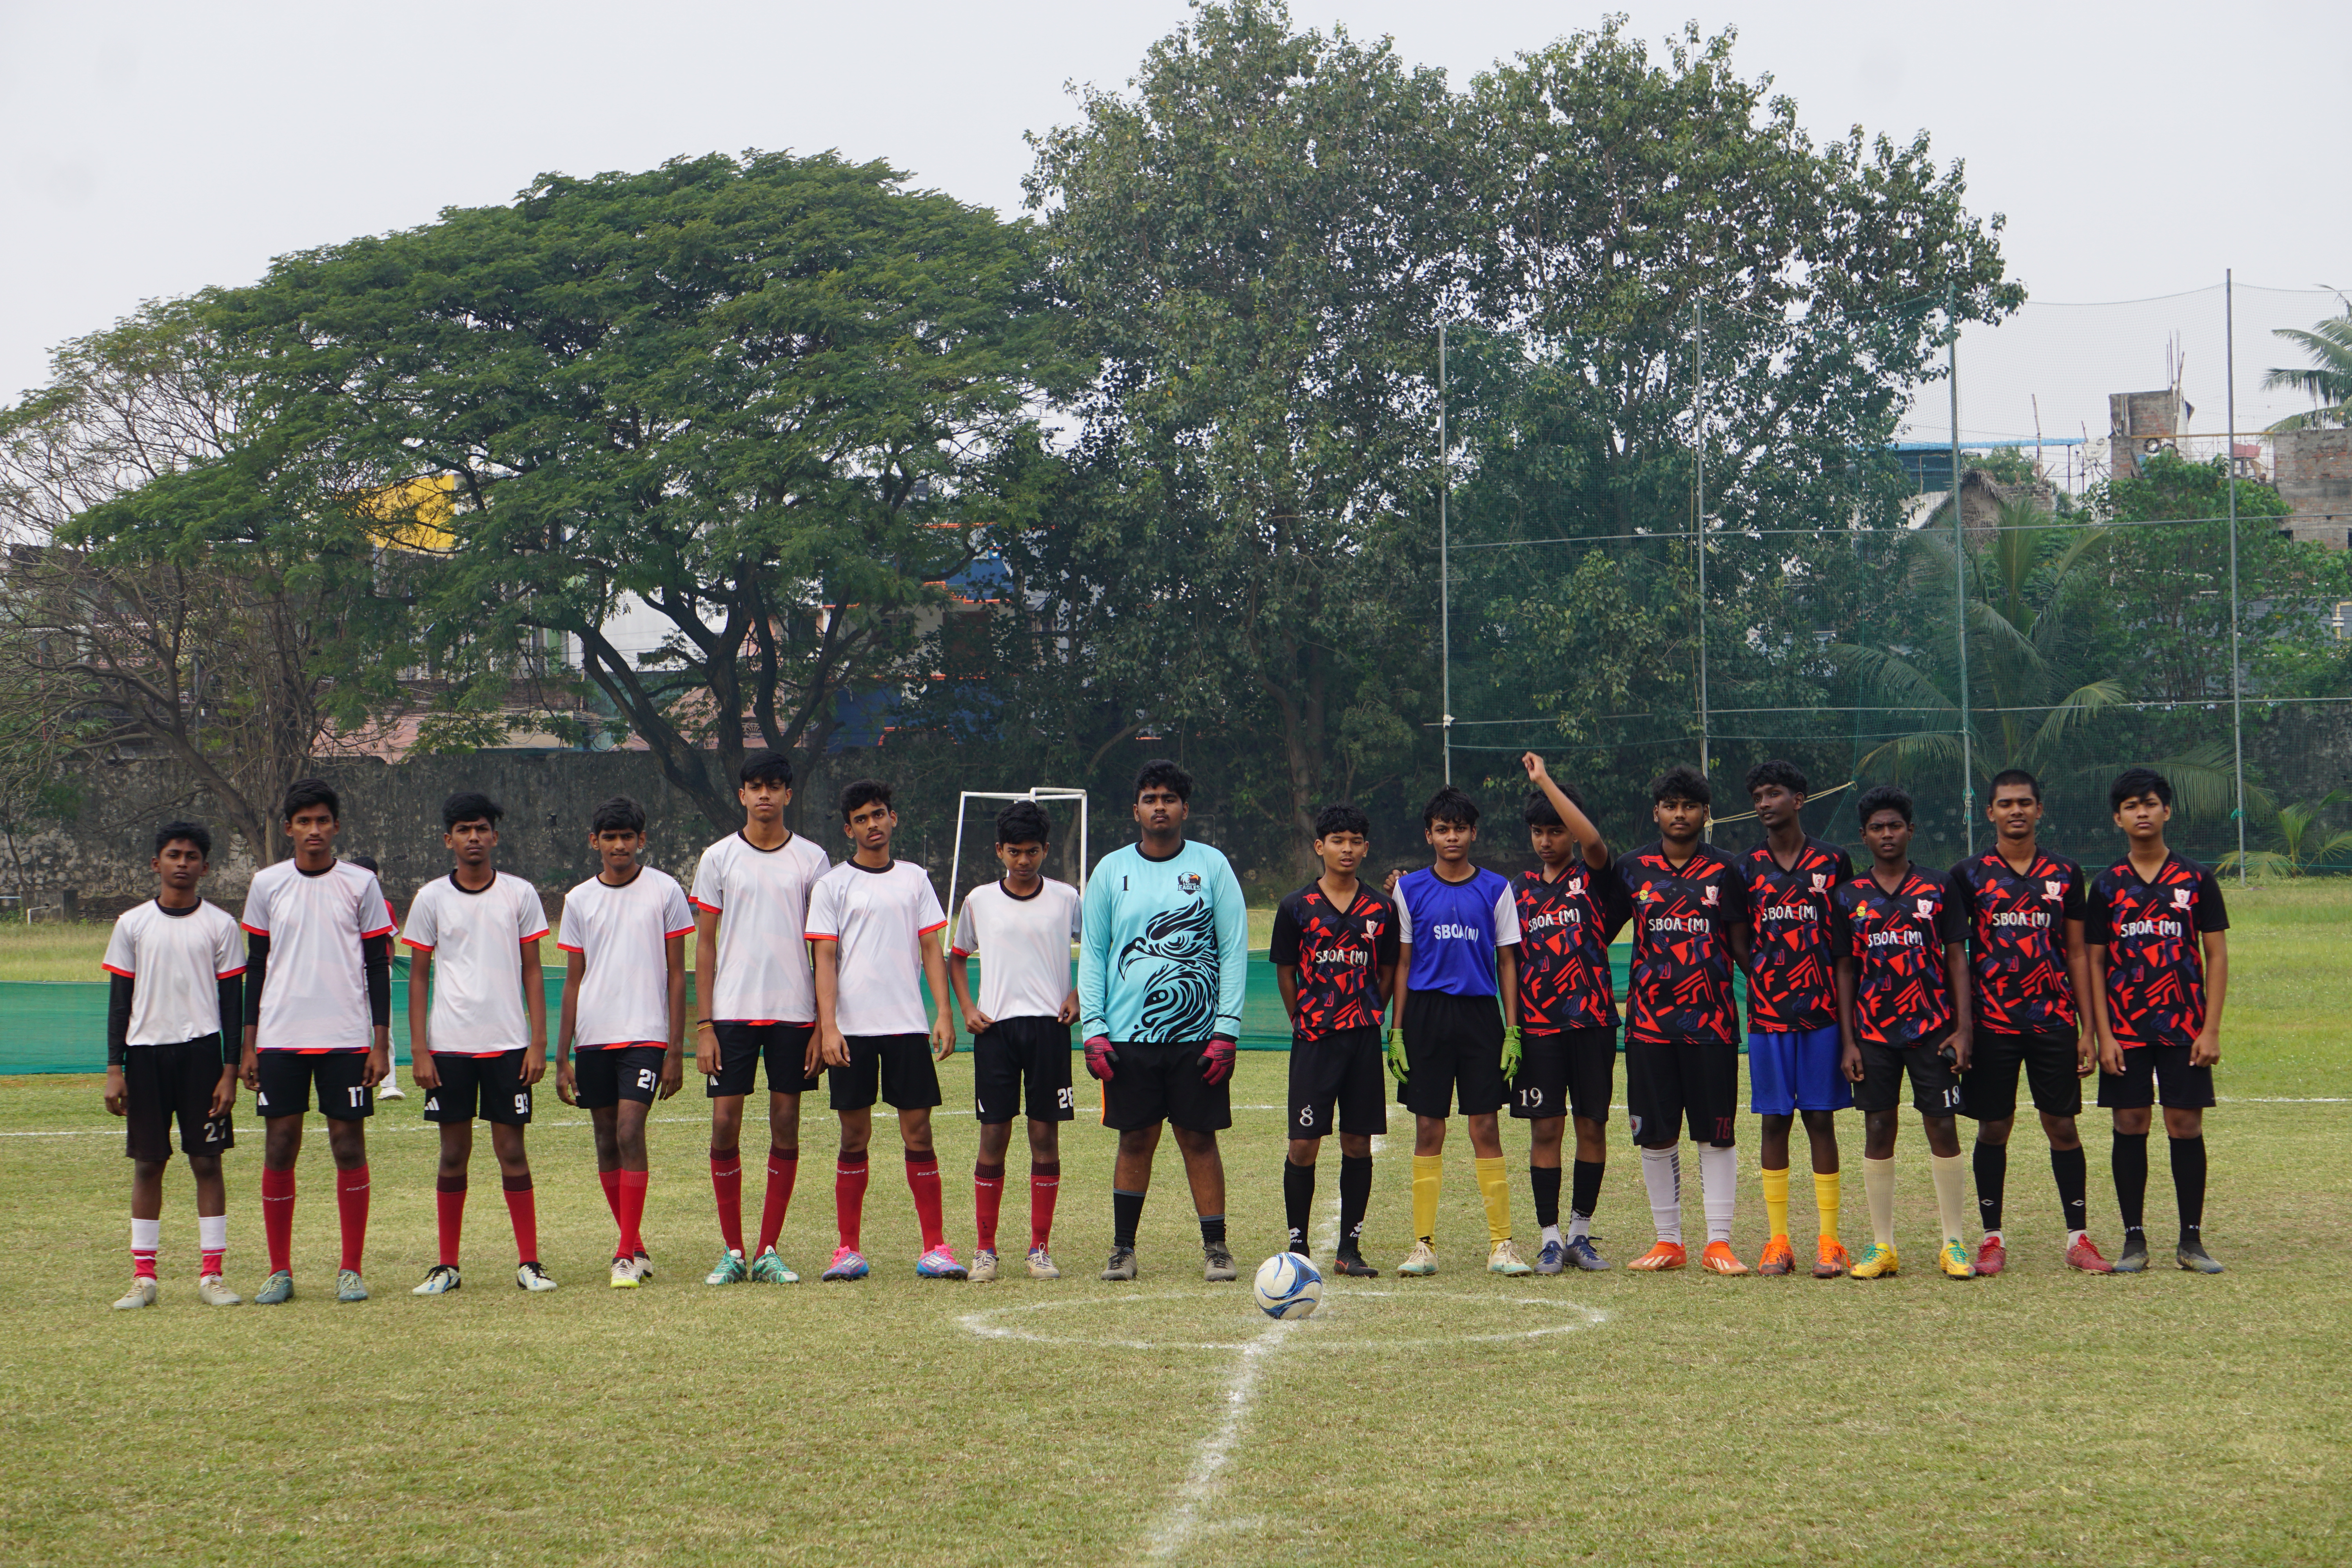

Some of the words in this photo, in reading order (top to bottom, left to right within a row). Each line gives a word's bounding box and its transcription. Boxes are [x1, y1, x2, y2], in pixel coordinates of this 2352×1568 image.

[1122, 875, 1129, 891] 1
[1529, 914, 1555, 933] SBOA
[1559, 908, 1581, 926] (M)
[1762, 906, 1794, 922] SBOA
[1993, 913, 2028, 927] SBOA
[2032, 912, 2051, 927] (M)
[1648, 918, 1681, 933] SBOA
[1688, 918, 1710, 934] (M)
[2121, 920, 2154, 938] SBOA
[2159, 920, 2182, 938] (M)
[1868, 932, 1899, 948] SBOA
[1904, 931, 1923, 947] (M)
[1316, 949, 1345, 965] SBOA
[1350, 951, 1368, 966] (M)
[637, 1069, 657, 1093] 21
[348, 1086, 364, 1107] 17
[515, 1093, 528, 1114] 93
[1519, 1087, 1543, 1108] 19
[1942, 1085, 1960, 1108] 18
[1299, 1104, 1314, 1127] 8
